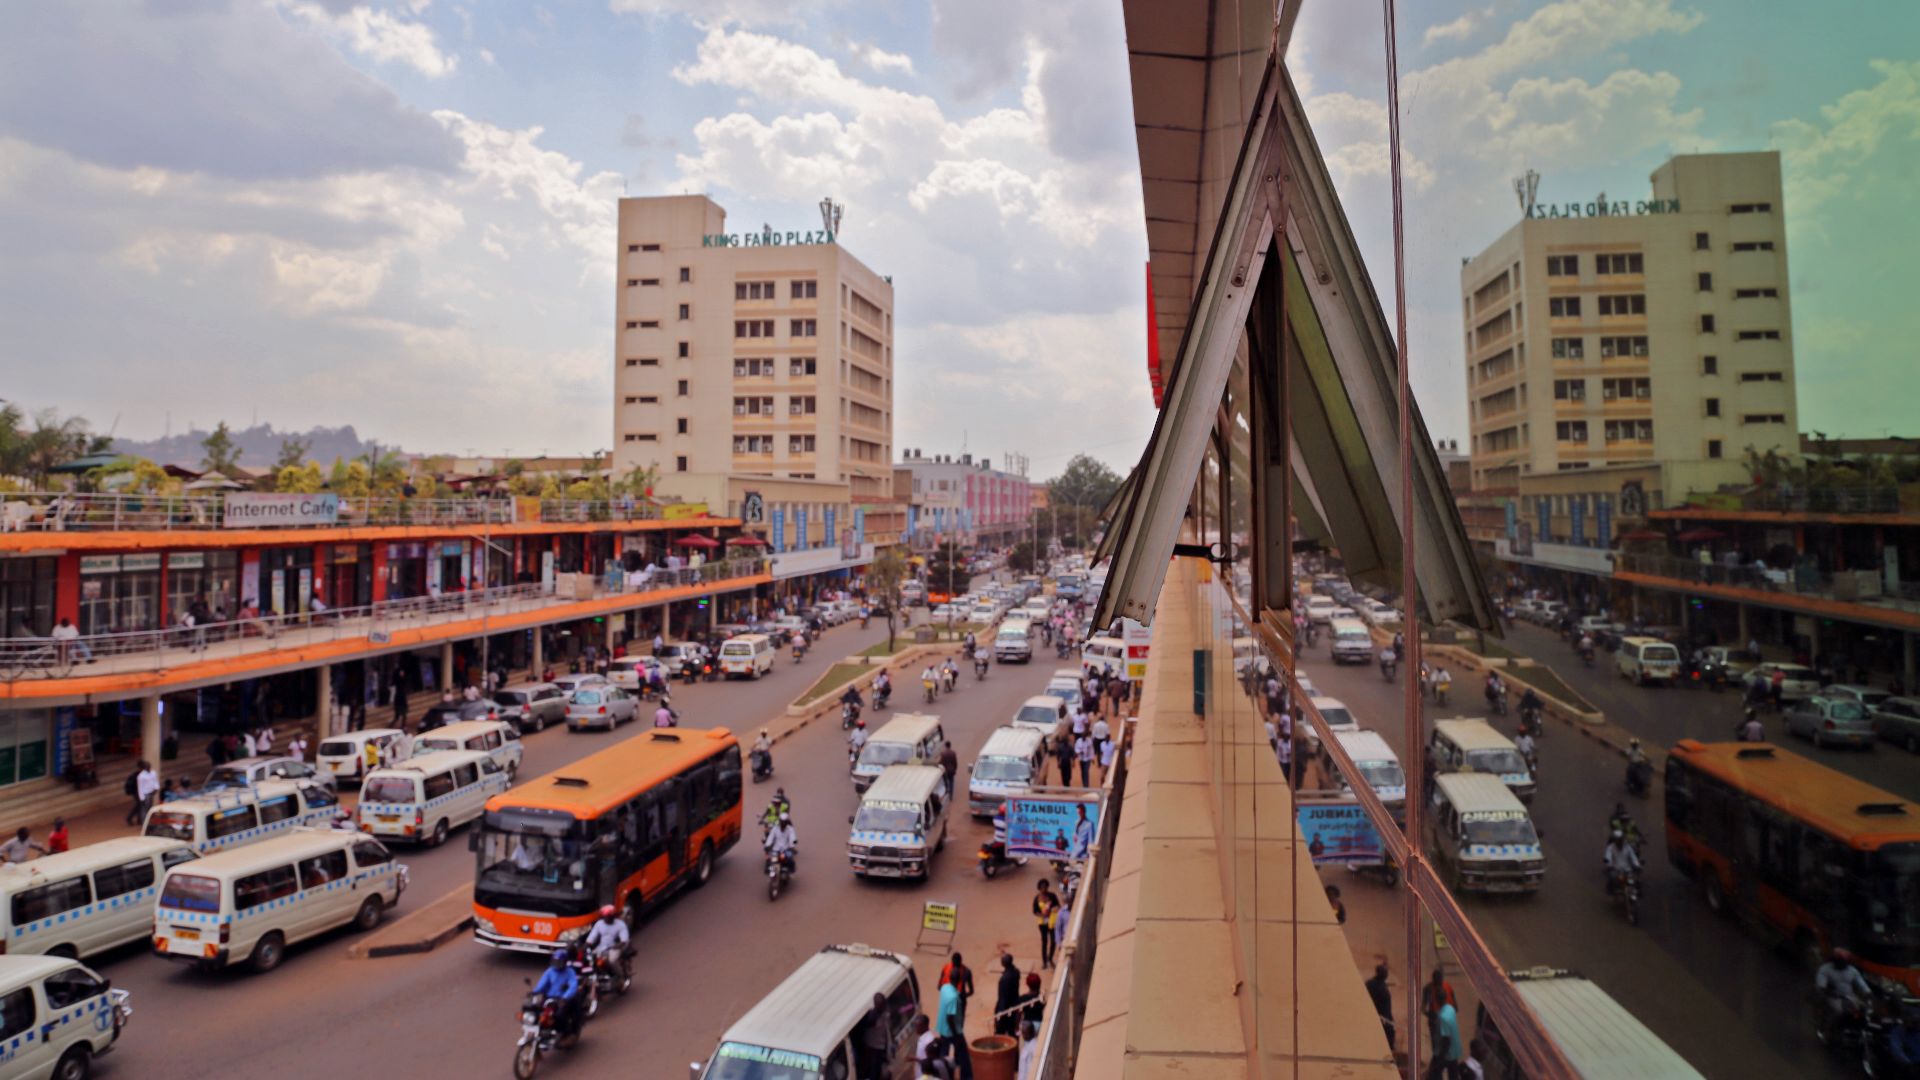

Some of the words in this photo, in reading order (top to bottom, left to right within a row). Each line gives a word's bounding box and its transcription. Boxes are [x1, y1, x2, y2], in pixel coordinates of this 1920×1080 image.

[703, 233, 739, 248] KING
[786, 230, 836, 246] PLAZA
[227, 502, 294, 517] Internet
[300, 499, 335, 515] Cafe
